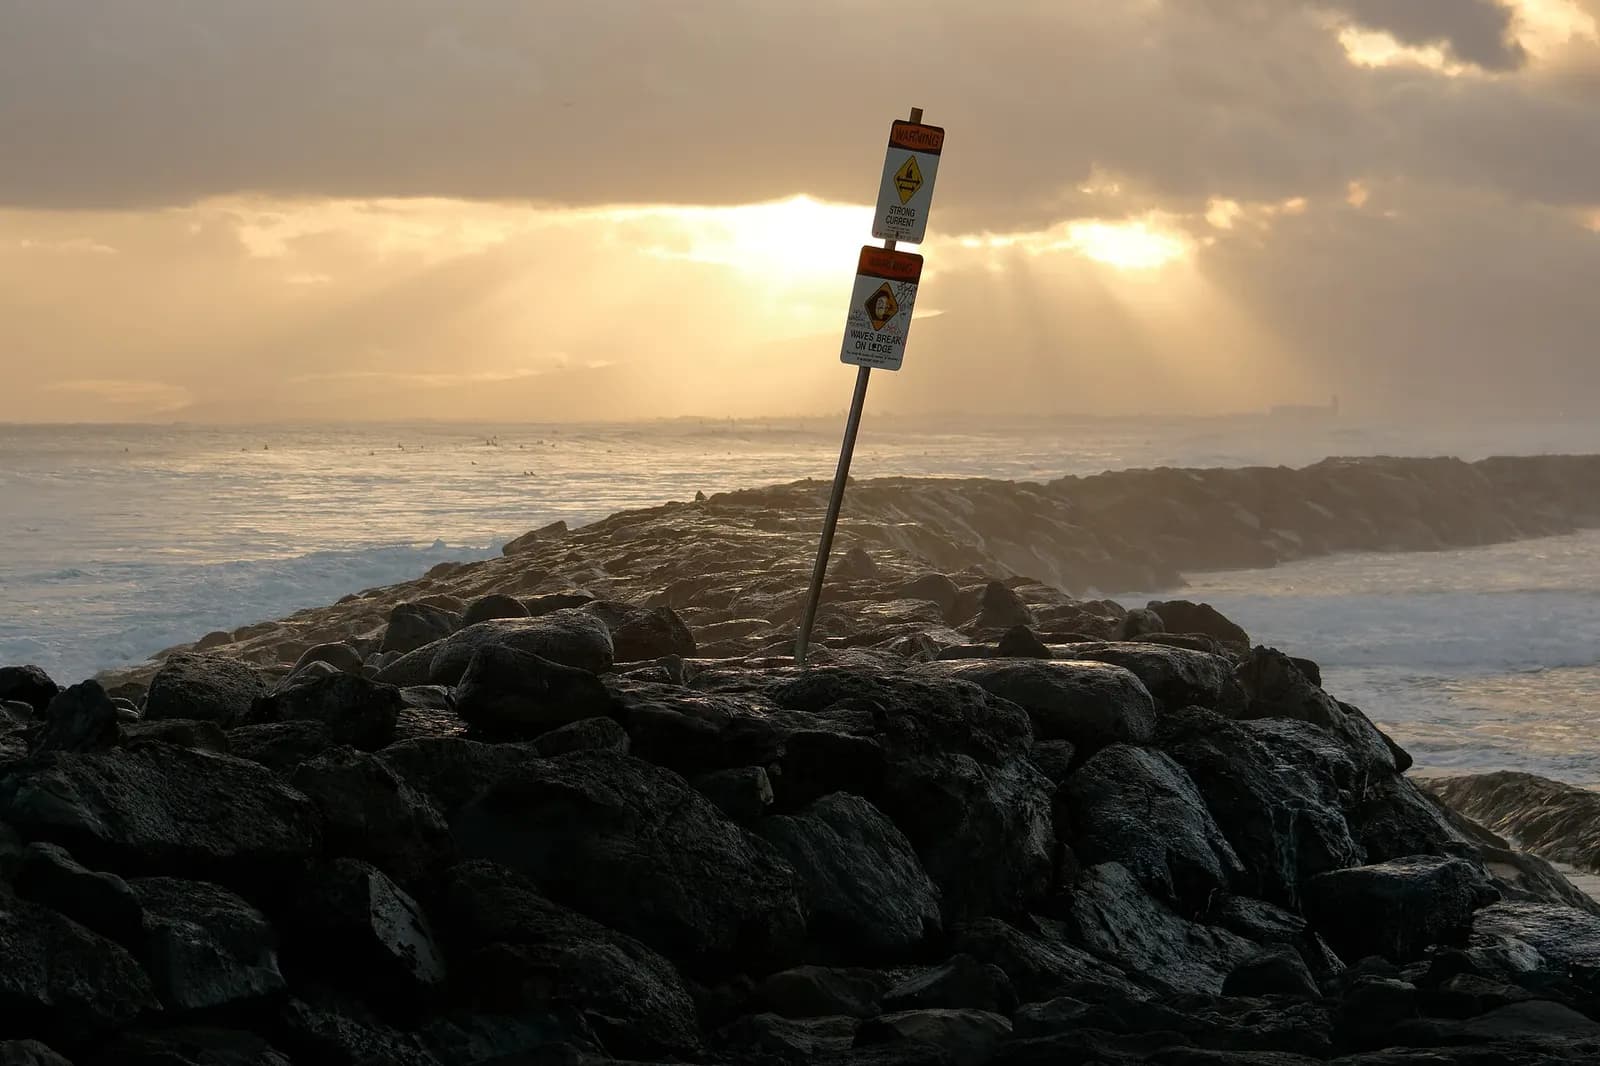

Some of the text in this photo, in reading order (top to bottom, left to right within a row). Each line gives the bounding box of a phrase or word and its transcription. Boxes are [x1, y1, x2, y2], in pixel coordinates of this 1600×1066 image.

[895, 127, 939, 147] WARNING
[889, 206, 916, 217] STRONG
[885, 215, 916, 227] CURRENT
[850, 329, 902, 345] WAVES BREAK
[855, 341, 893, 354] ON LEDGE
